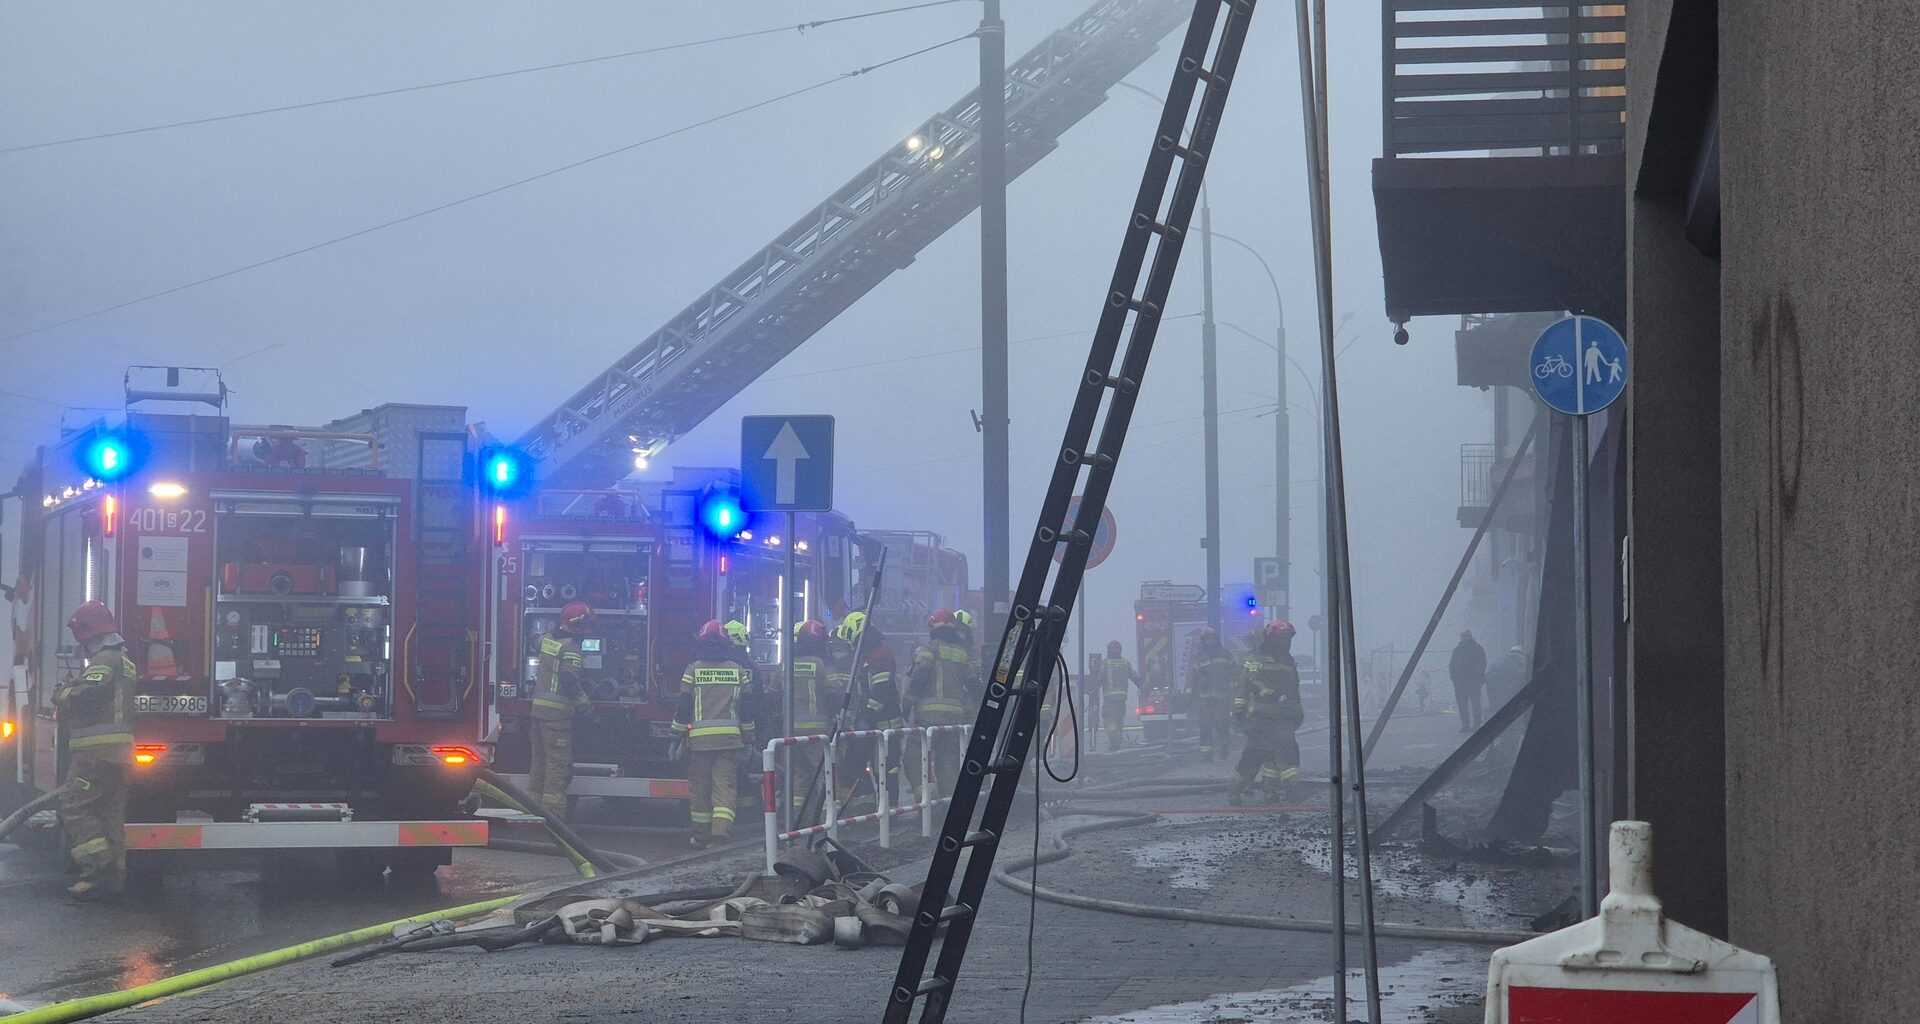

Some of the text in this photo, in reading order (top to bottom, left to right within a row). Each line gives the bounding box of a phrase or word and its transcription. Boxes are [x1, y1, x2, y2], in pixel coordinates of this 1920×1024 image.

[613, 383, 654, 418] MAGIRUS
[129, 507, 165, 531] 401
[179, 509, 206, 532] 22
[1261, 560, 1280, 586] P
[162, 697, 206, 712] 3998G
